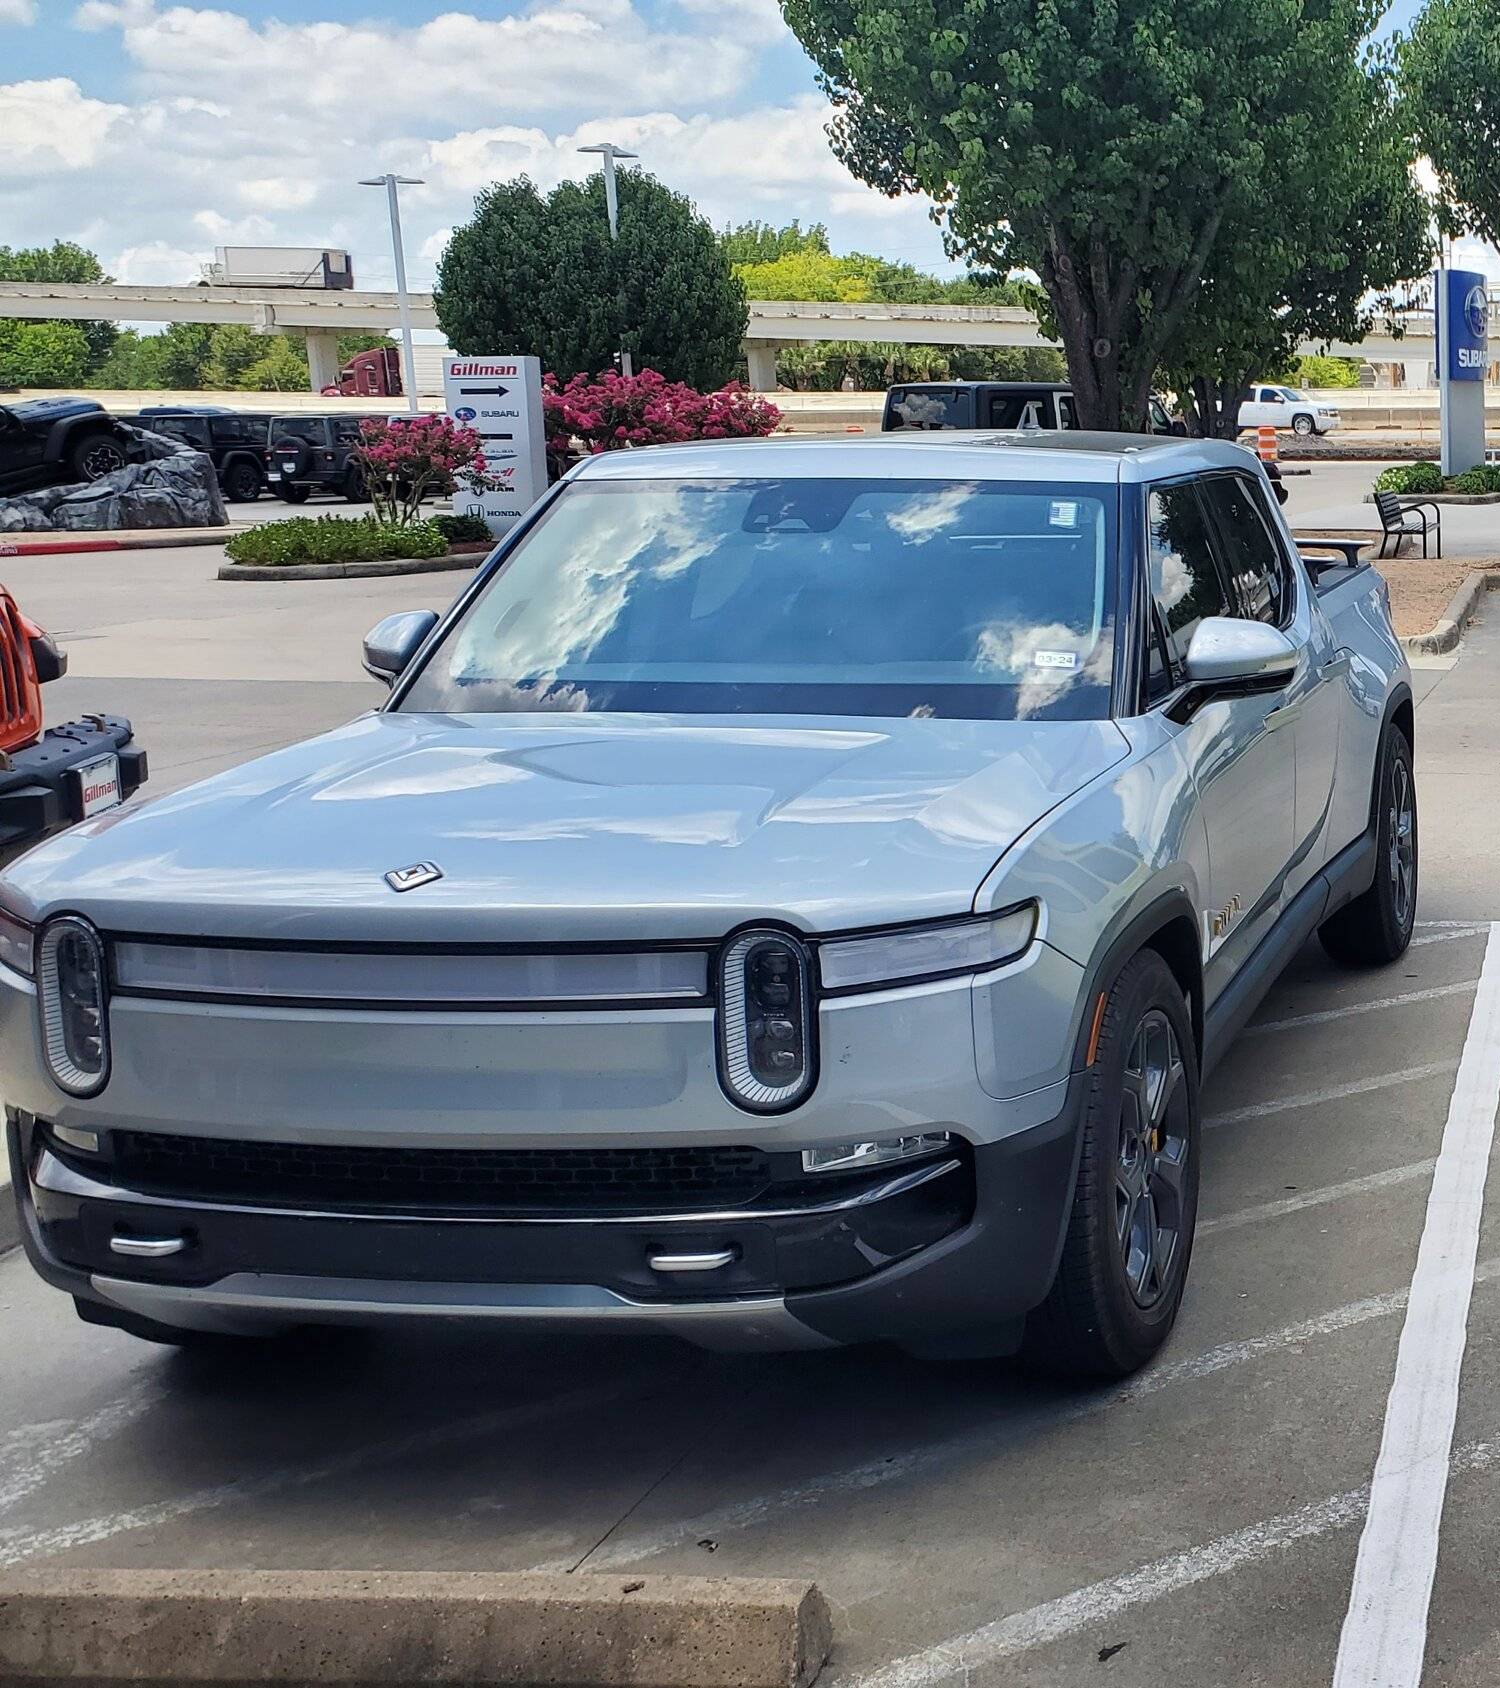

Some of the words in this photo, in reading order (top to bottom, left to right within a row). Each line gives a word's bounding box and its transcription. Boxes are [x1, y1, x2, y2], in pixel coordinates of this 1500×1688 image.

[450, 363, 518, 376] Gillman
[481, 410, 520, 418] SUBARU
[84, 780, 117, 803] Gillman
